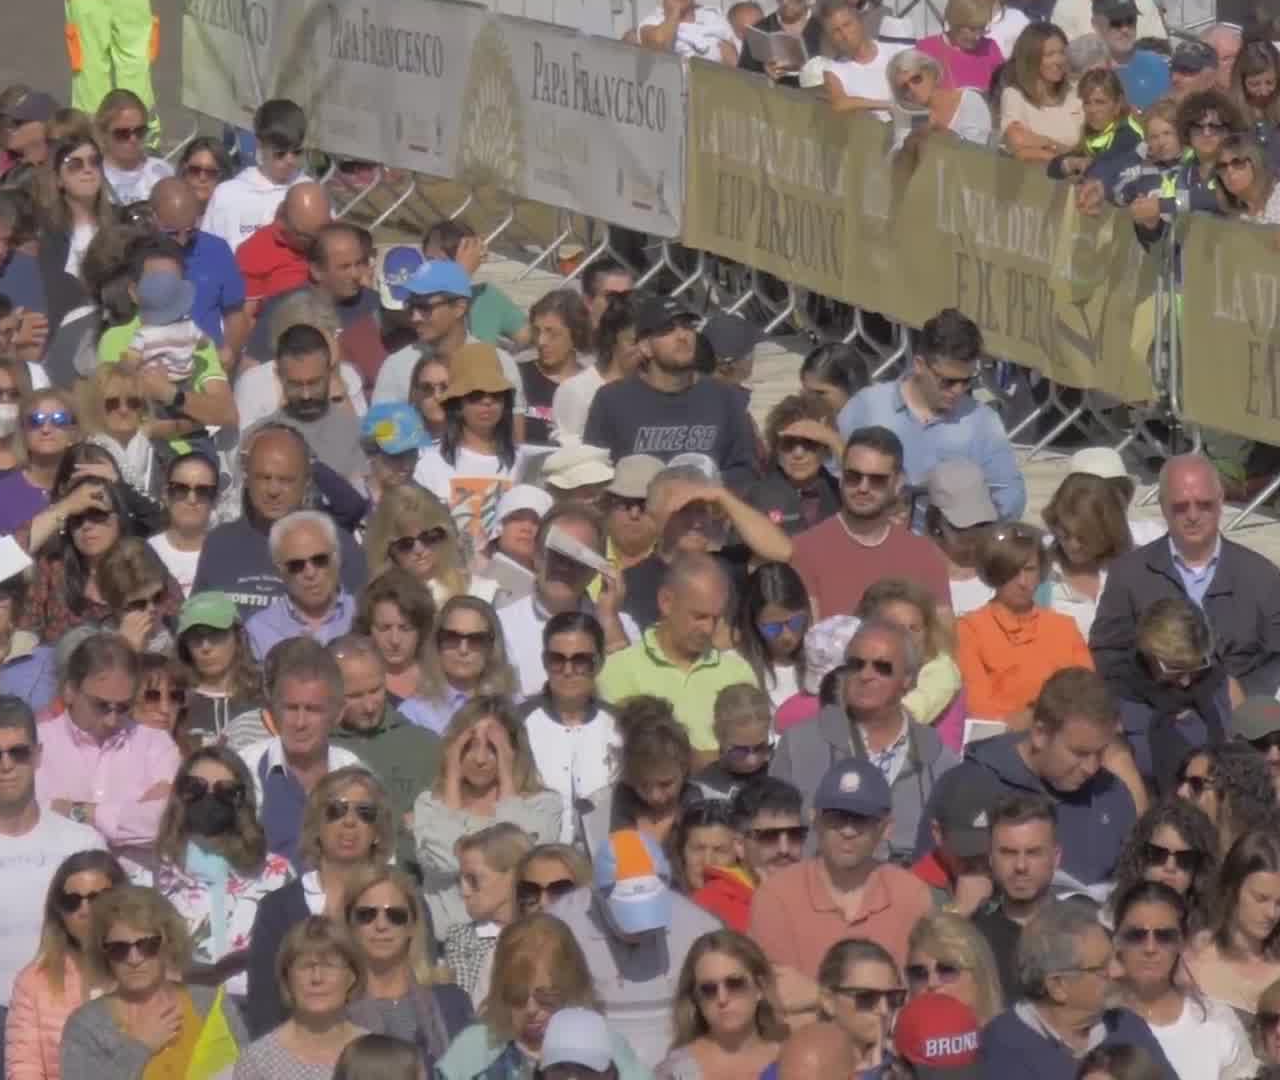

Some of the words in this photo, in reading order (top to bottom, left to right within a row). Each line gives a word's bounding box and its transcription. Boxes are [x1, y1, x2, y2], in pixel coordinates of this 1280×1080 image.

[329, 4, 361, 65] PAPA
[360, 7, 445, 78] FRANCESCO
[531, 40, 569, 108] PAPA
[571, 51, 667, 133] FRANCESCO
[1212, 243, 1248, 323] LA
